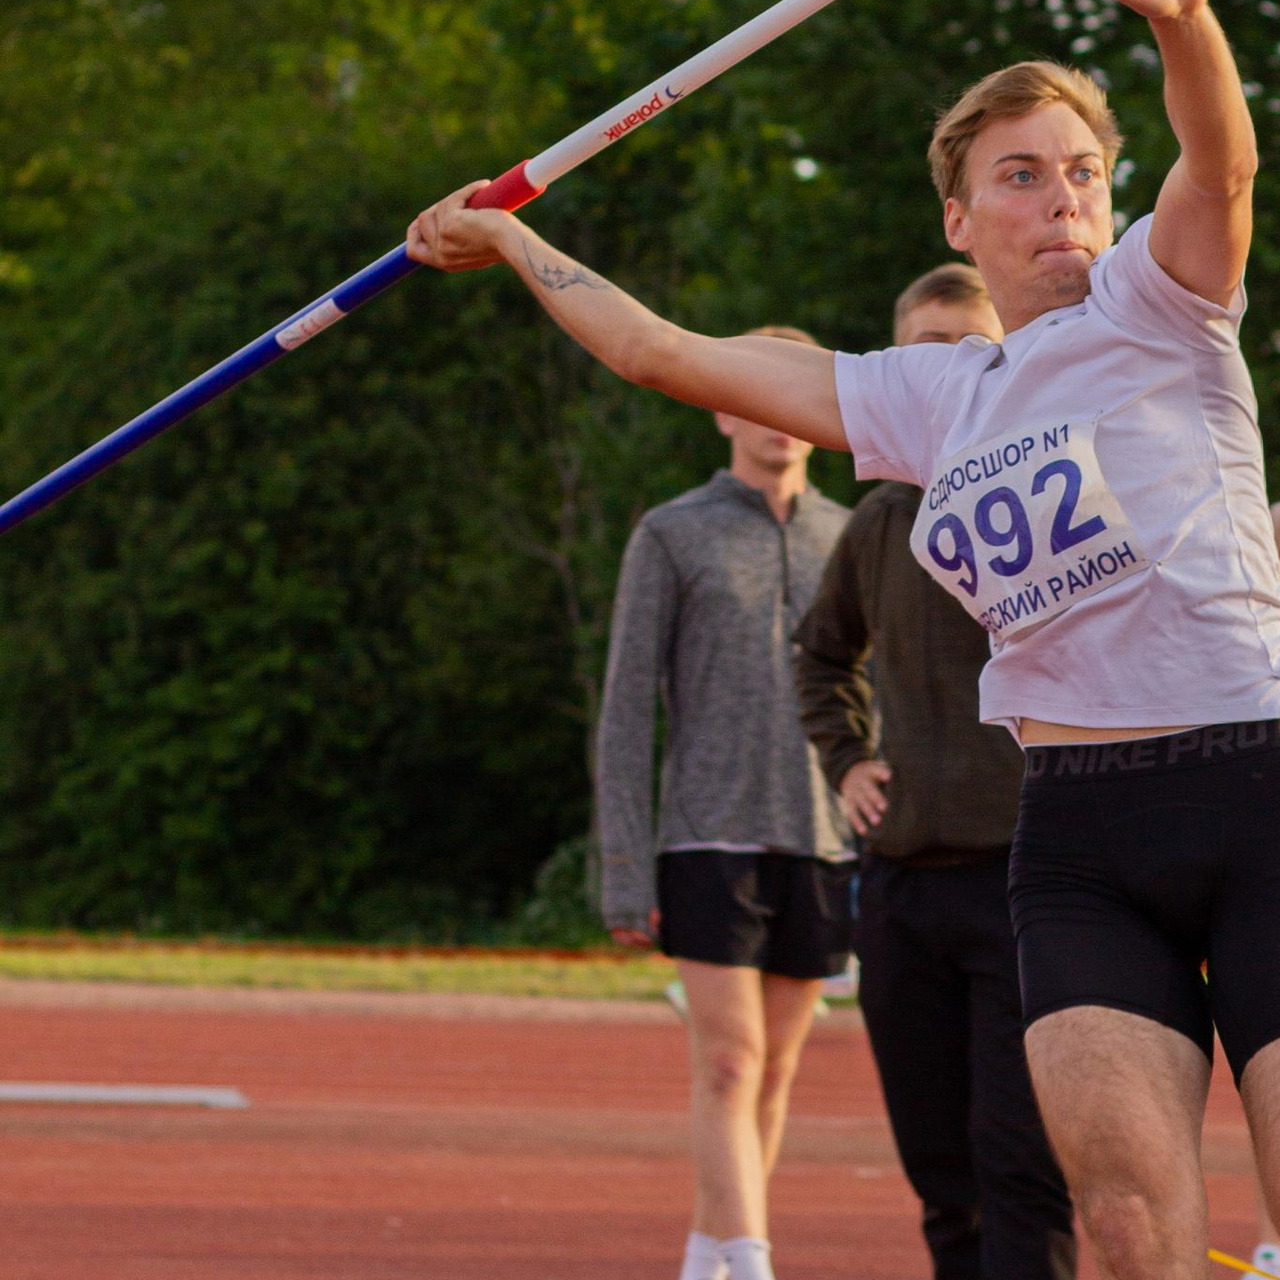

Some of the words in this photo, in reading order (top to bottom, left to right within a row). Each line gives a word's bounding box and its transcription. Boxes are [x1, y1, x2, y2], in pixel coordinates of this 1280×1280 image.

[603, 92, 664, 141] polanik
[929, 436, 1035, 510] СДЮСШОР
[927, 458, 1108, 598] 992
[1046, 541, 1137, 602] РАЙОН
[1053, 741, 1156, 777] NIKE
[1166, 720, 1268, 765] PRO
